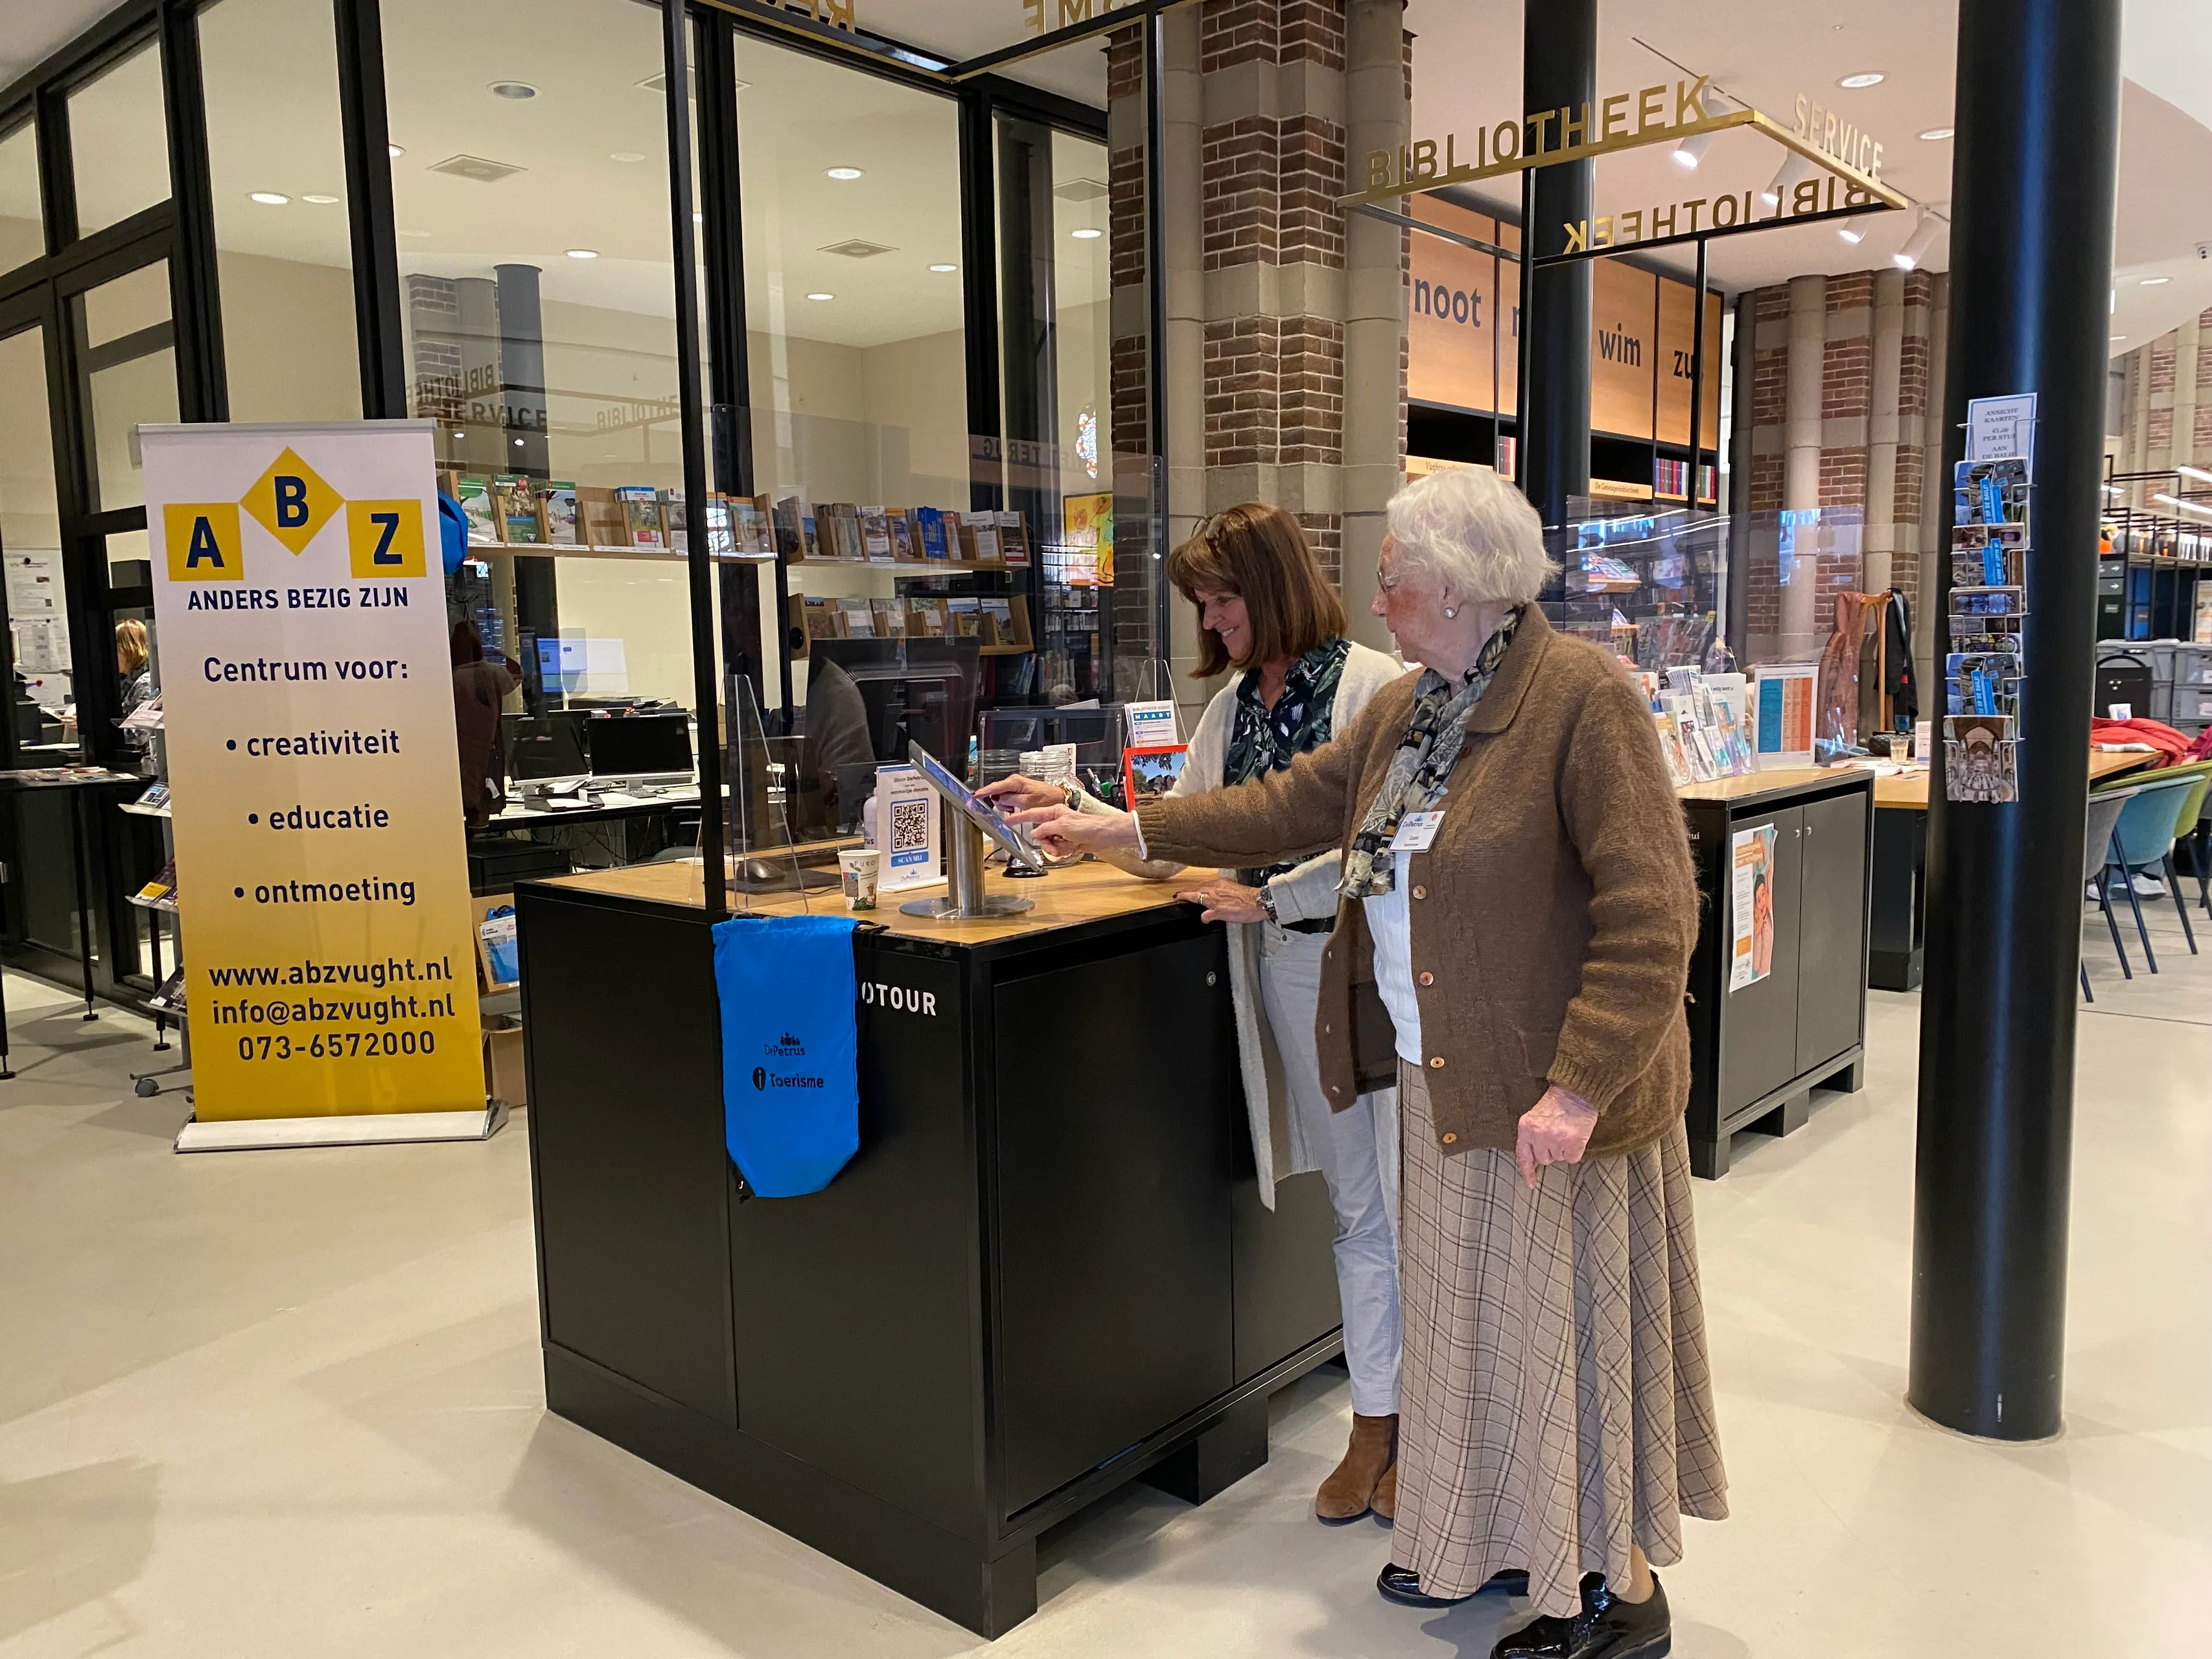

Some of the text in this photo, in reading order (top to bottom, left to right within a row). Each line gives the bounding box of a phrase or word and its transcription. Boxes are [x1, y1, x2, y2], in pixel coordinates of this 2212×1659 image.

[1367, 75, 1710, 194] BIBLIOTHEEK
[1793, 91, 1884, 183] SERVICE
[1414, 278, 1482, 328] noot
[1598, 322, 1641, 367] wim
[1673, 350, 1696, 380] zu
[1984, 415, 2020, 423] KAARTEN
[1985, 407, 2019, 416] ANSICHT
[188, 586, 408, 611] ANDERS BEZIG ZIJN
[204, 656, 408, 683] Centrum voor:
[247, 730, 401, 756] creativiteit
[270, 804, 389, 830] educatie
[255, 876, 416, 905] ontmoeting
[209, 957, 453, 989] www.abzvught.nl
[213, 993, 456, 1027] info@abzvught.nl
[238, 1030, 436, 1061] 073-6572000
[764, 1044, 806, 1057] DePetrus
[769, 1073, 824, 1089] Toerisme
